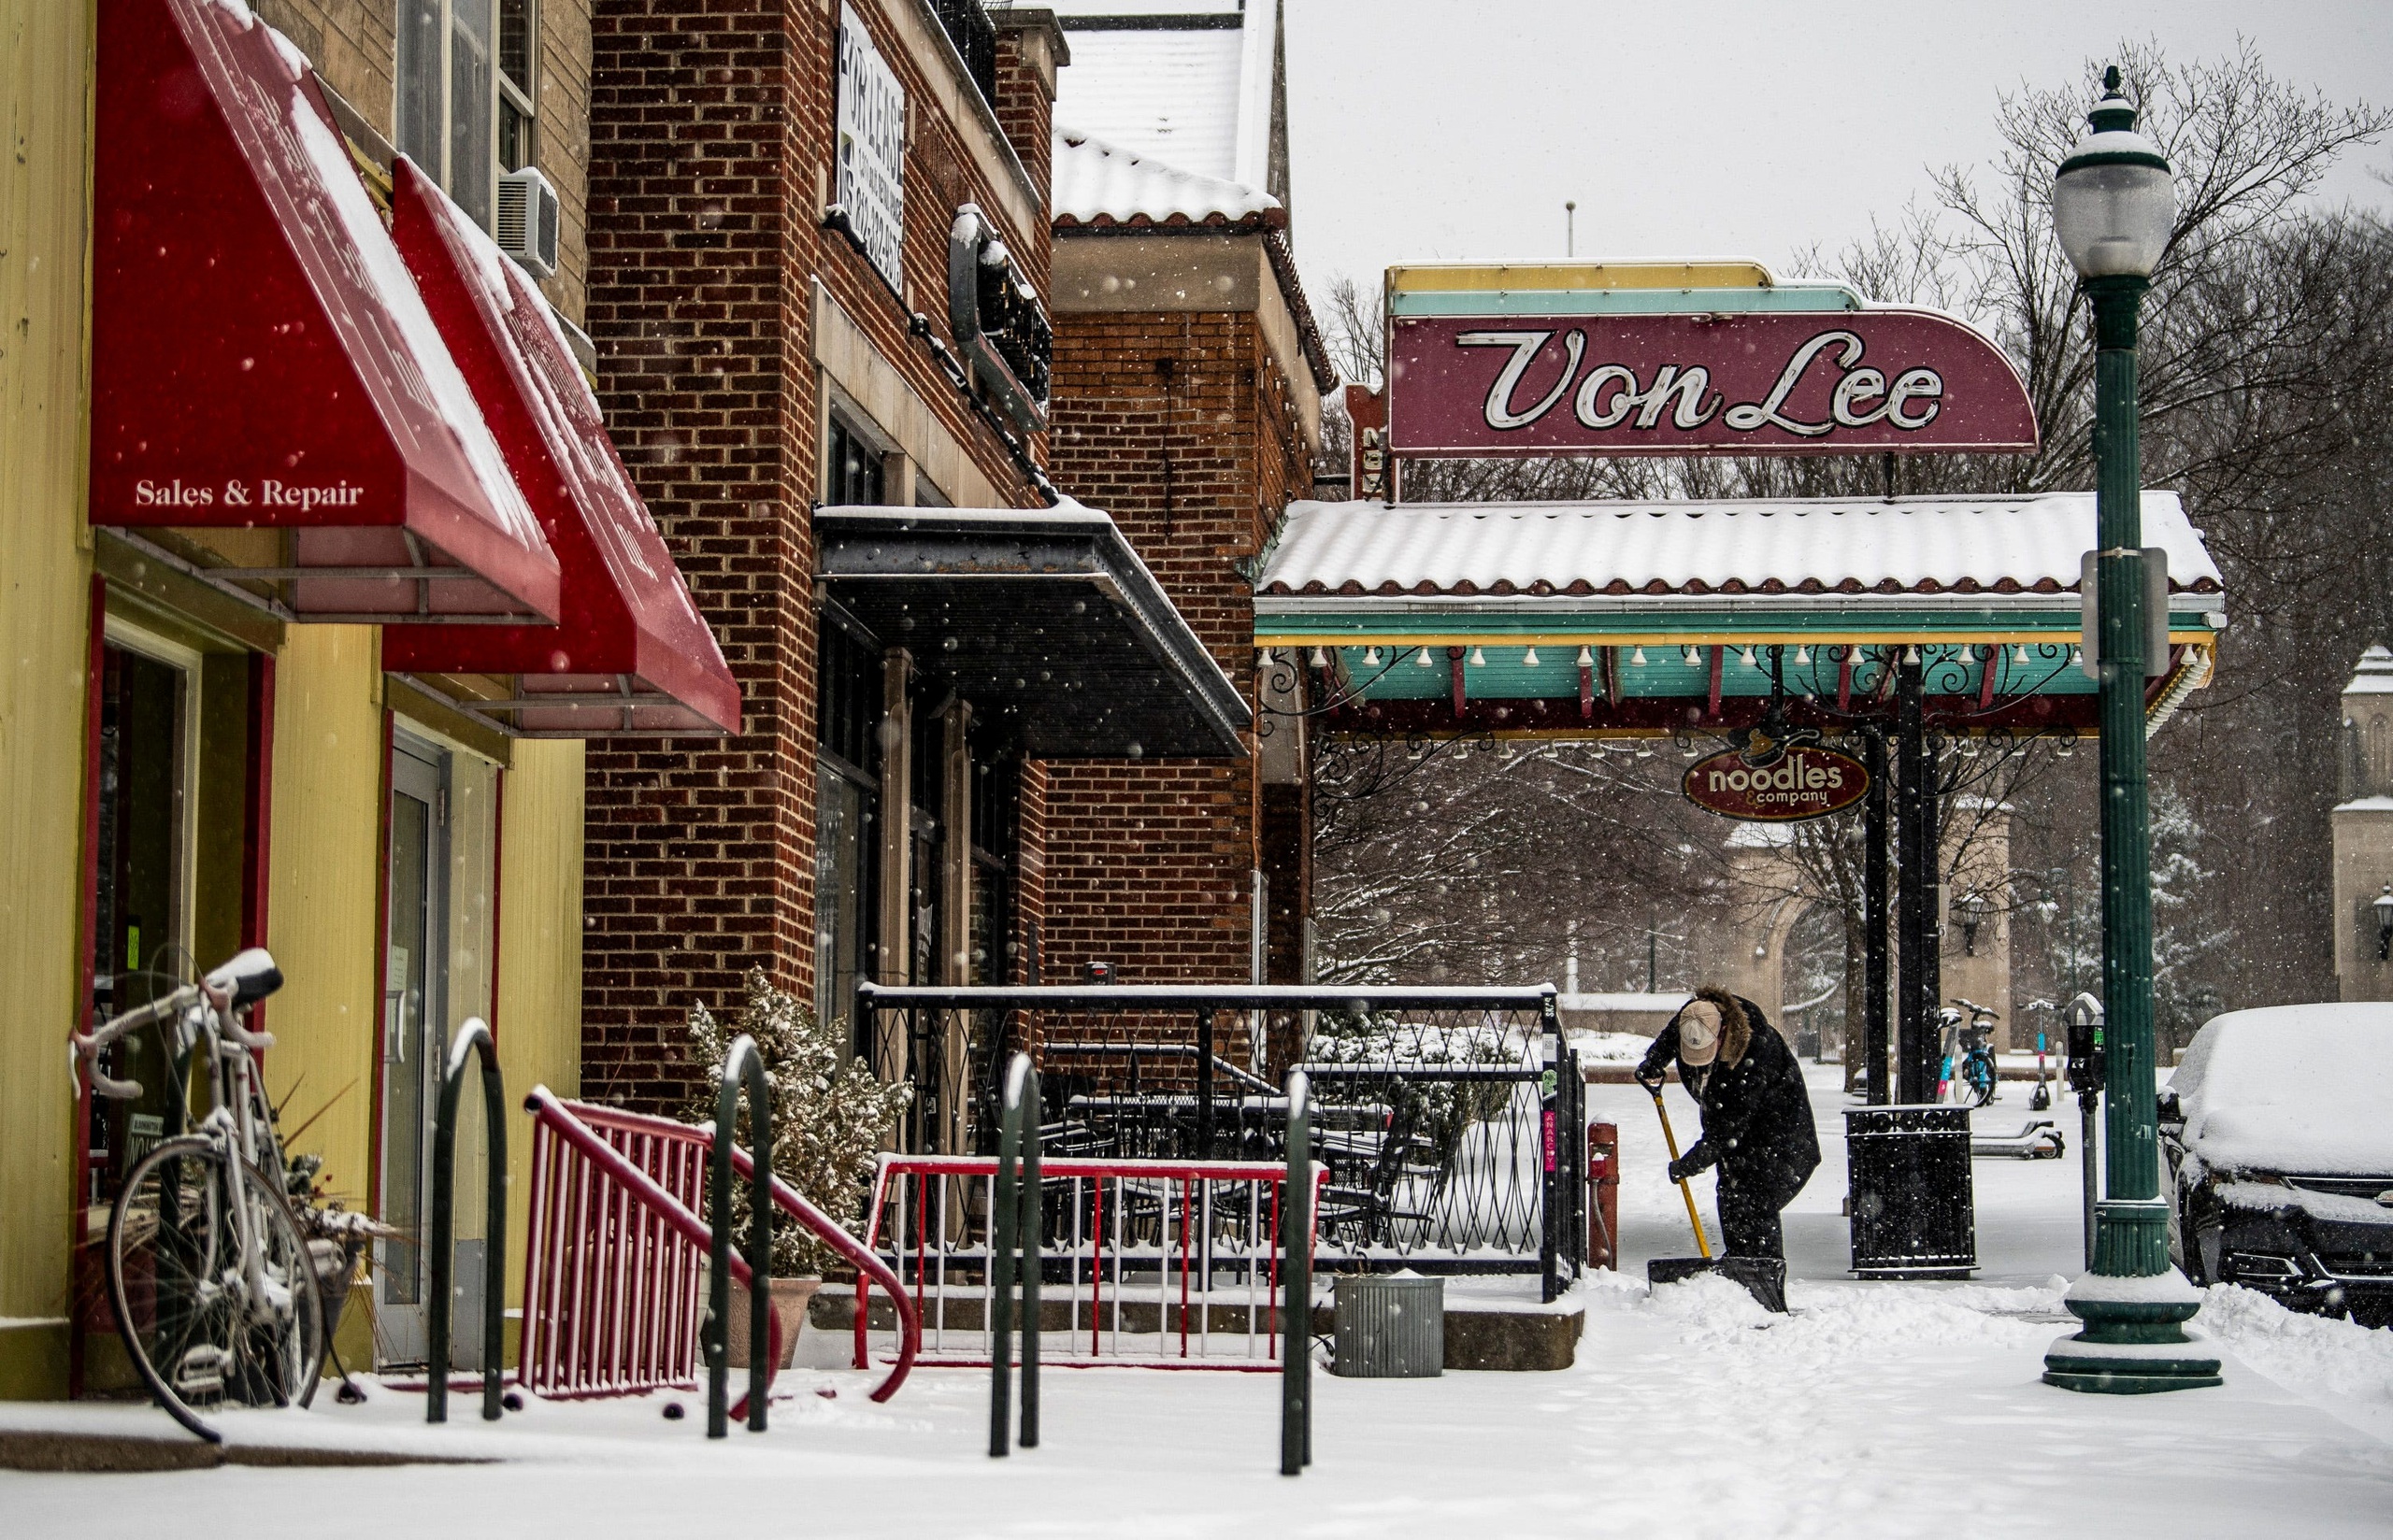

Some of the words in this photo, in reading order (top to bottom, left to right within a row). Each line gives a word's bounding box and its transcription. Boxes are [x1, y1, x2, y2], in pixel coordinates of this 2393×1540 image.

[840, 22, 867, 138] FOR
[869, 63, 904, 186] LEASE
[1455, 328, 1724, 432] Von
[1724, 329, 1943, 436] Lee
[136, 478, 214, 506] Sales
[223, 478, 252, 506] &
[262, 478, 365, 513] Repair
[1709, 753, 1843, 792] noodles
